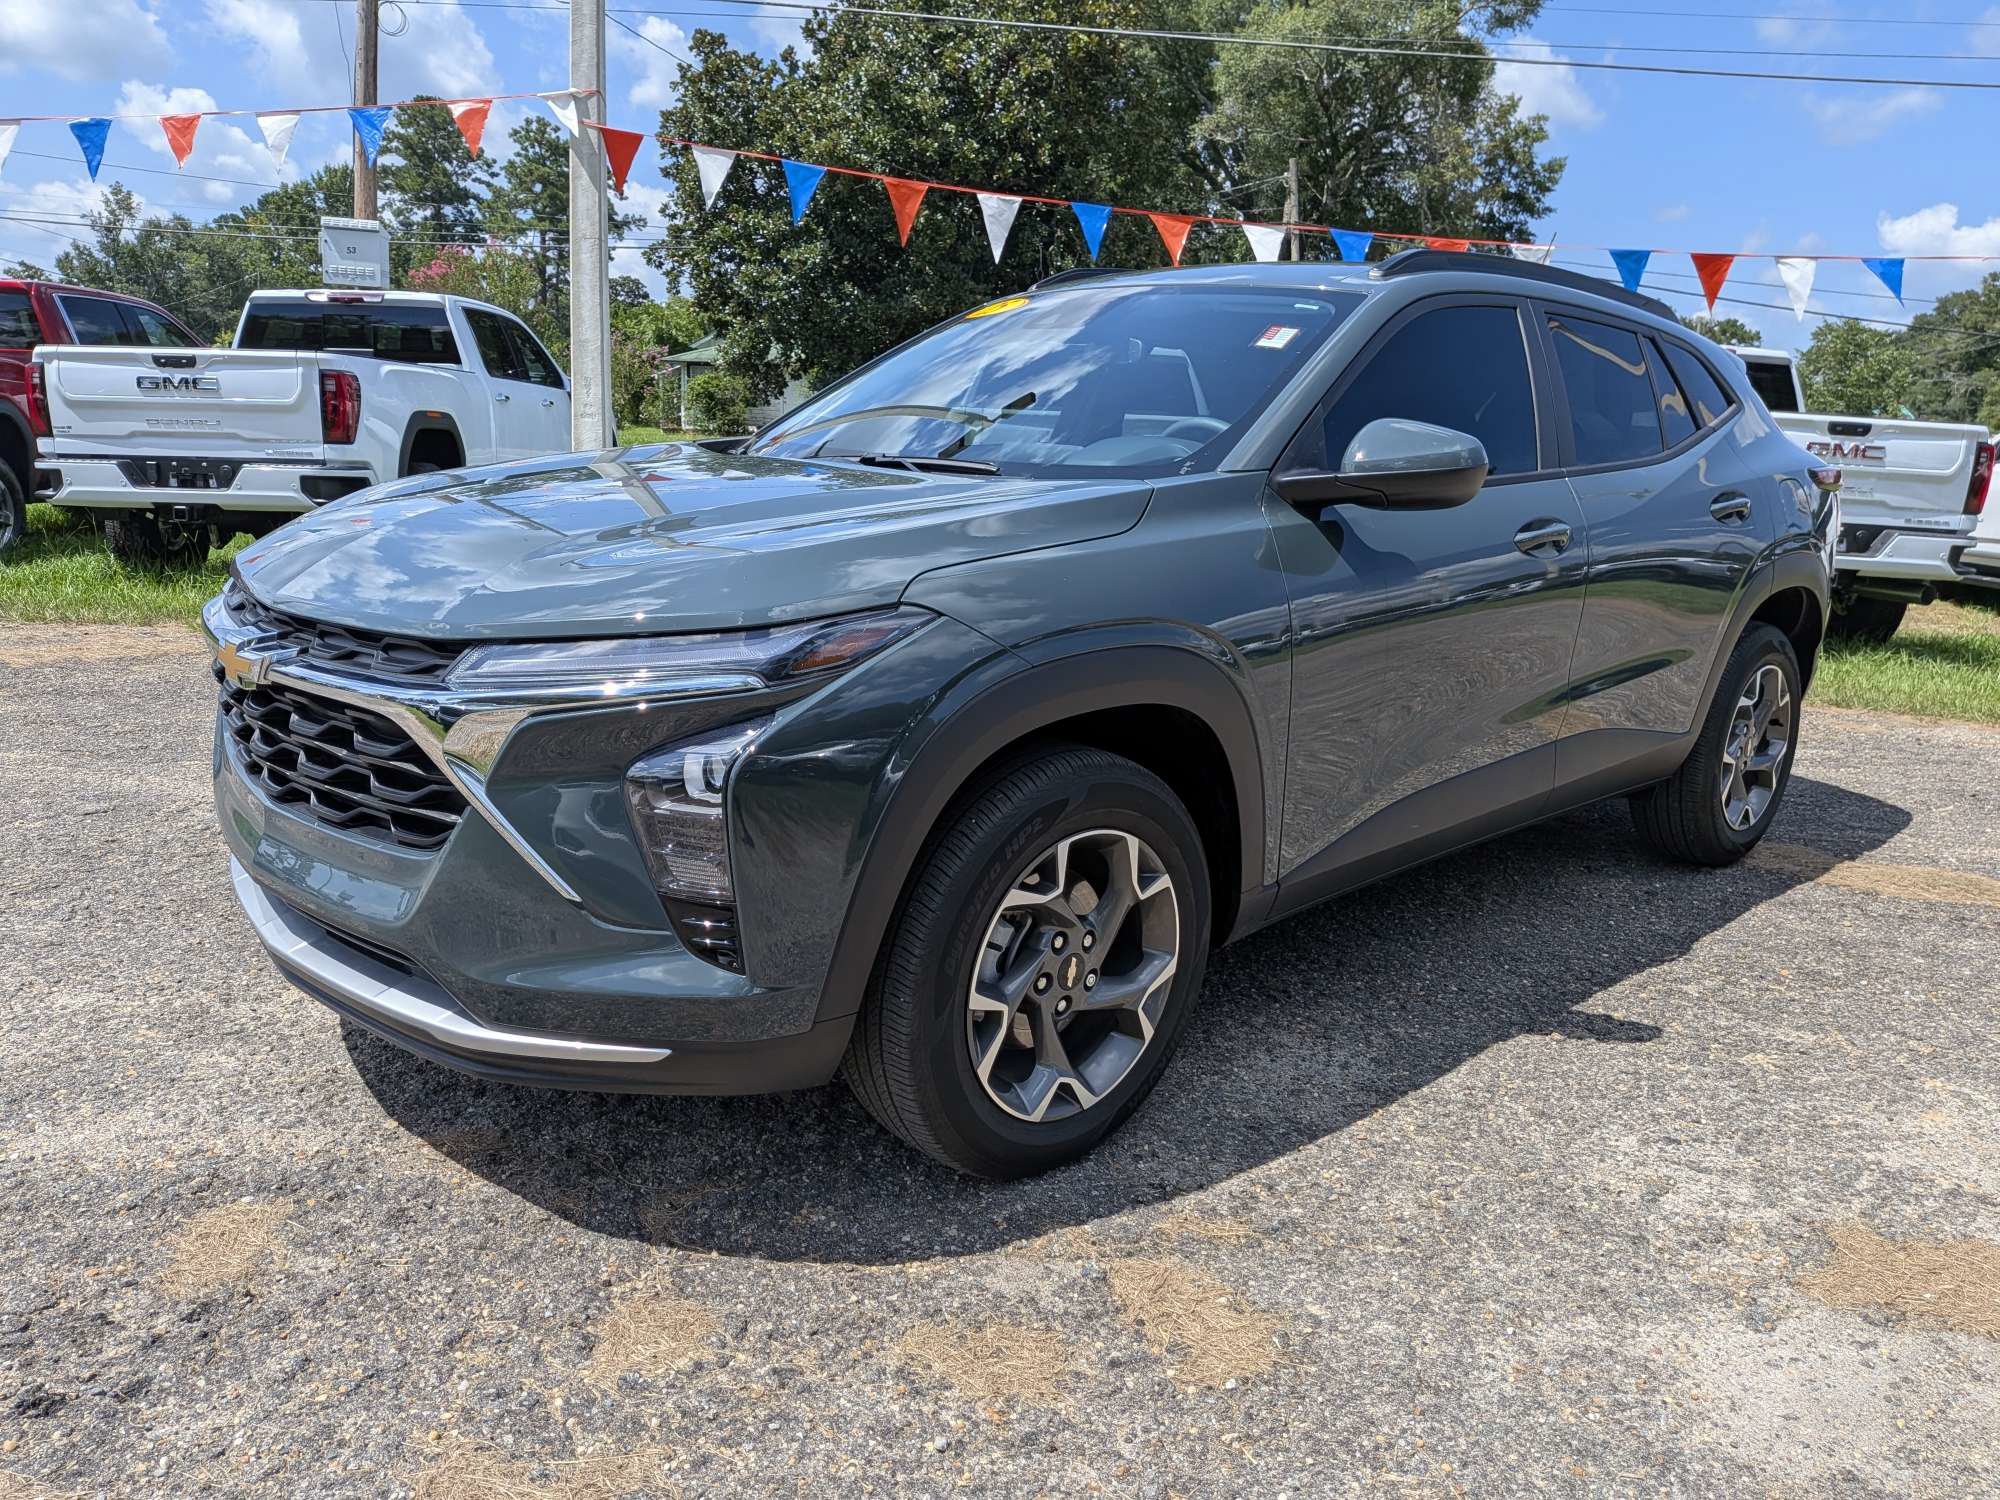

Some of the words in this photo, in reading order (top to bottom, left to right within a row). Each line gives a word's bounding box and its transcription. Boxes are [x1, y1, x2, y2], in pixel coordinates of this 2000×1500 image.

[346, 246, 357, 255] 53
[136, 376, 218, 391] GMC
[1807, 442, 1886, 459] GMC
